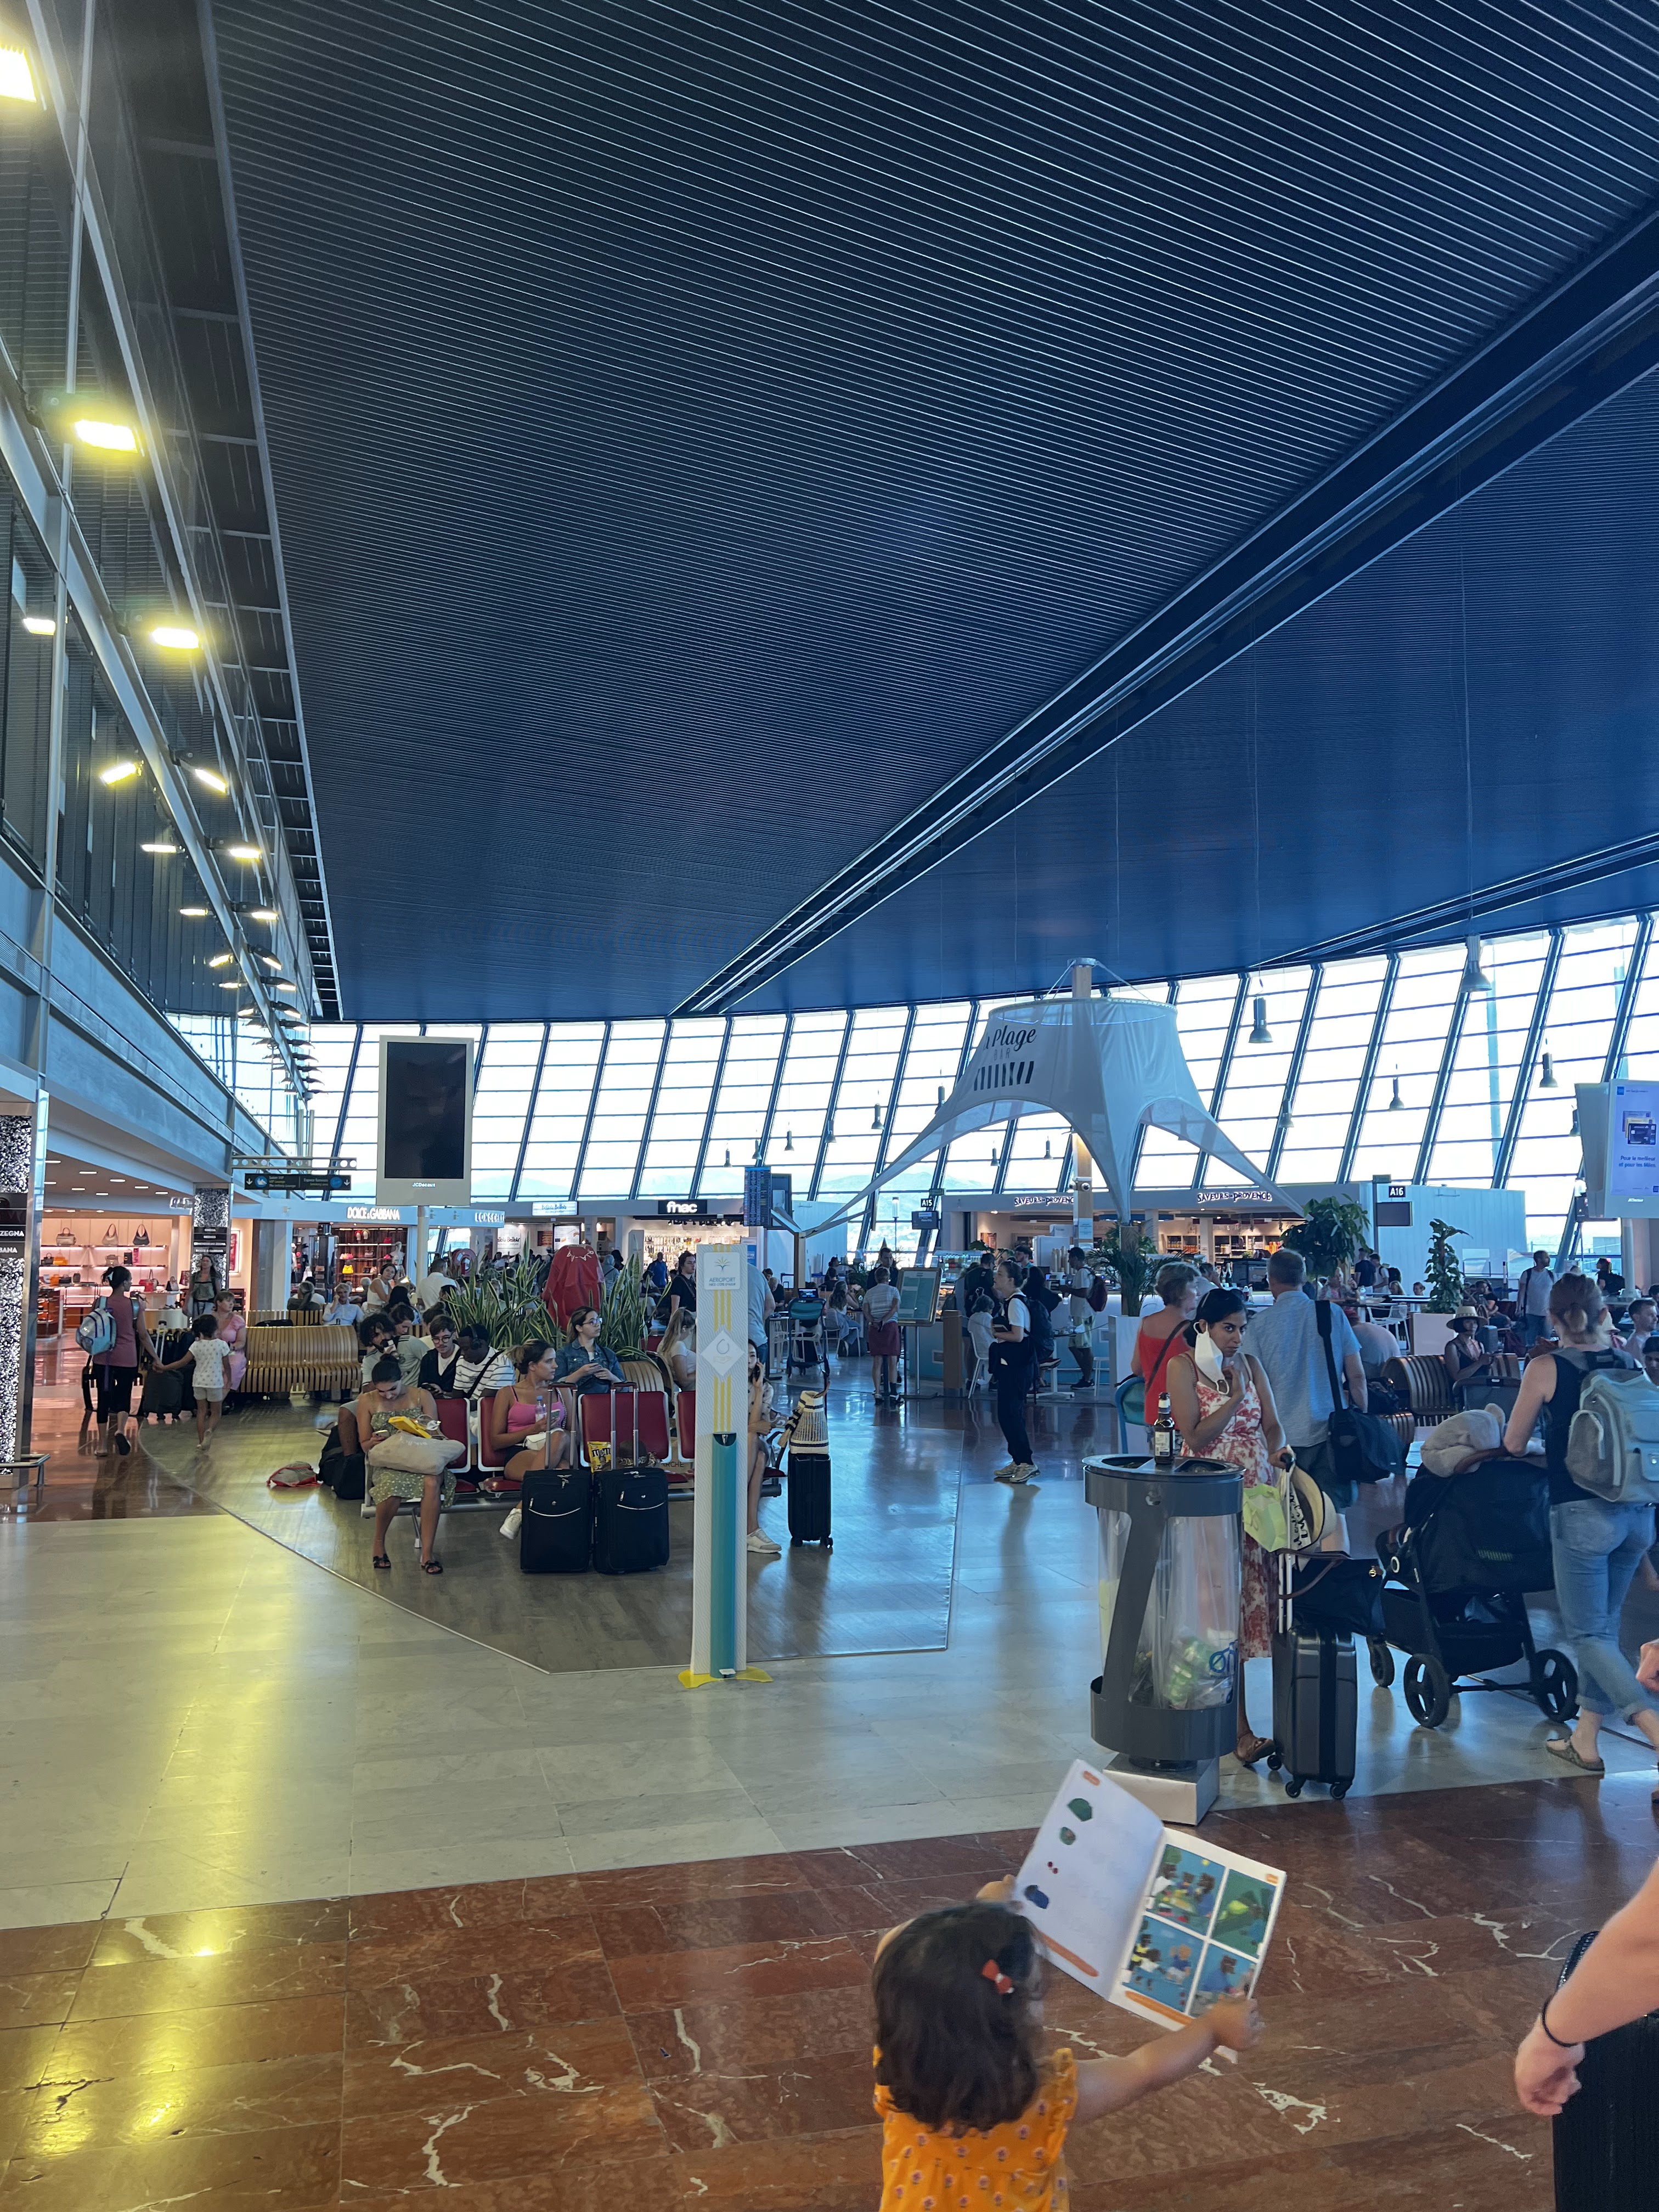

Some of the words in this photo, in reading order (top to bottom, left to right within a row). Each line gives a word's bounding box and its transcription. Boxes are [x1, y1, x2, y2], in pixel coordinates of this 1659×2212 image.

[991, 1025, 1037, 1052] Plage
[994, 1048, 1010, 1061] BAR
[1198, 1192, 1229, 1204] SAVEURS
[1233, 1190, 1273, 1203] PROVENCE
[1390, 1187, 1404, 1196] A16
[667, 1201, 698, 1214] fnac
[1014, 1197, 1043, 1207] SAVEURS
[1046, 1197, 1074, 1206] PROVENC
